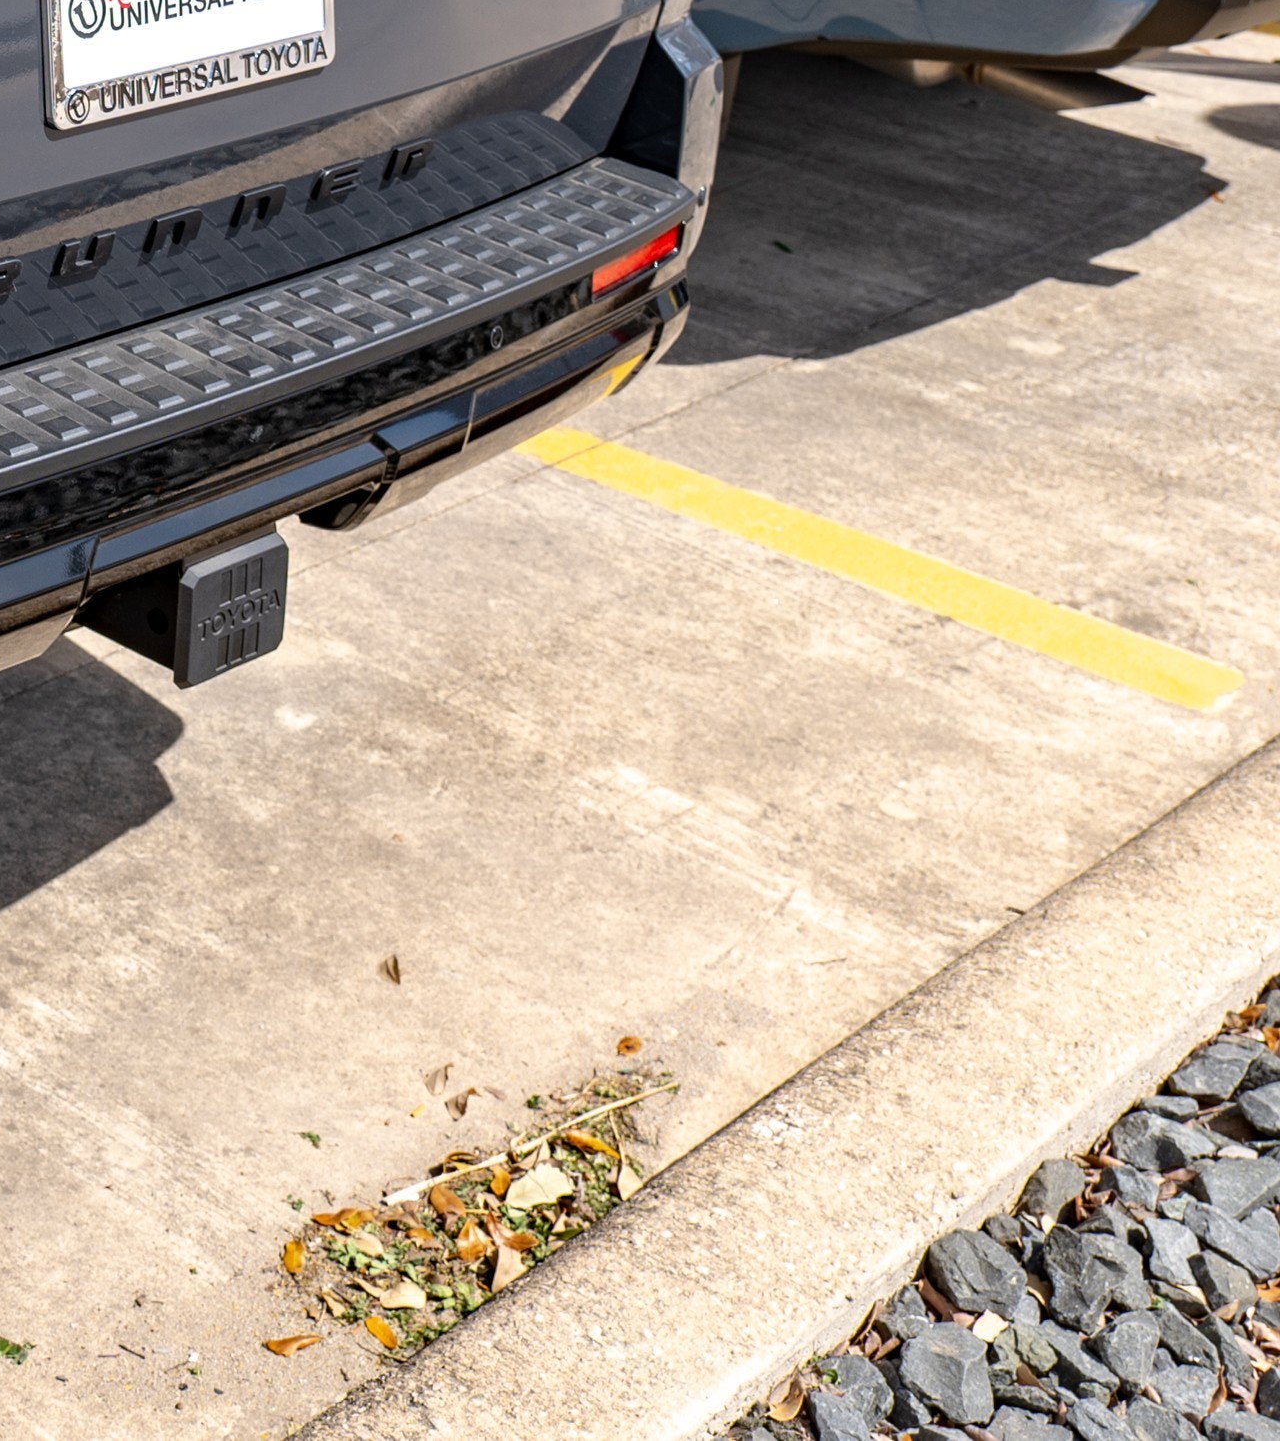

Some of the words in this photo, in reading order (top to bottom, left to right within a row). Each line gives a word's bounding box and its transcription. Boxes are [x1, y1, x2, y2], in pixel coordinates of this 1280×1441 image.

[99, 58, 238, 113] UNIVERSAL
[240, 36, 328, 77] TOYOTA
[197, 589, 282, 641] TOYOTA
